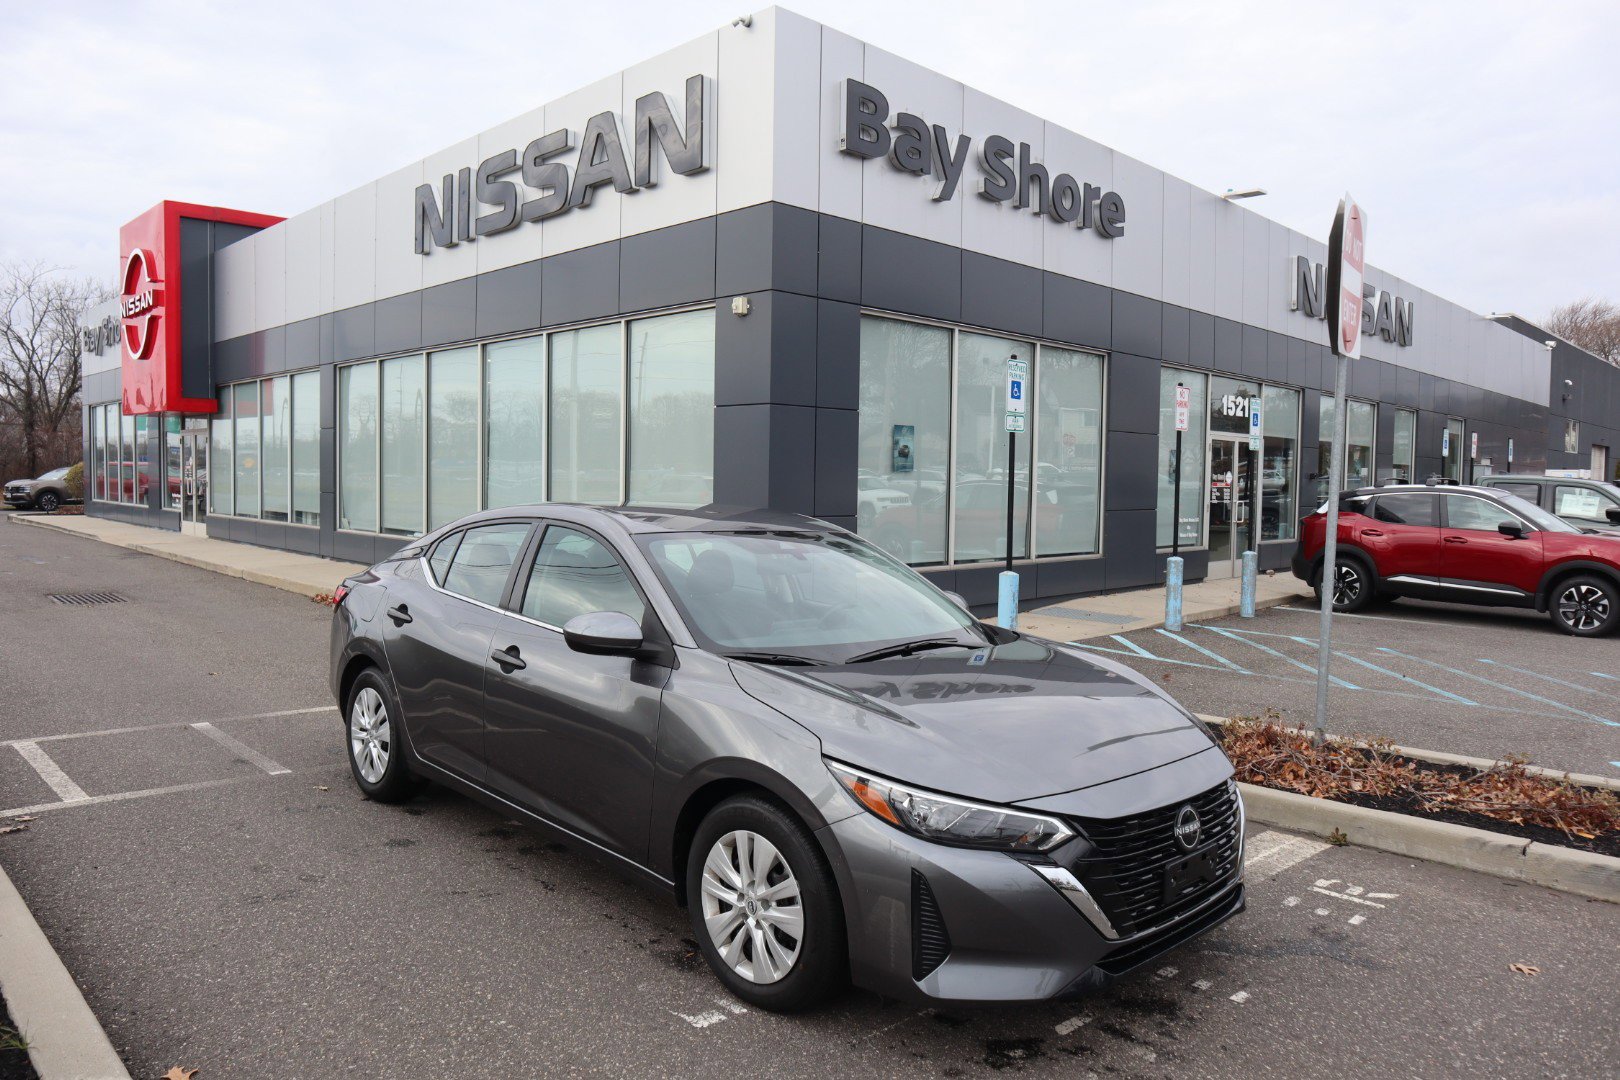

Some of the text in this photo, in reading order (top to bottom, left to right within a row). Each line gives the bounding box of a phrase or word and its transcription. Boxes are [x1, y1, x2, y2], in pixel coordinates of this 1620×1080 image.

[414, 73, 710, 256] NISSAN
[841, 78, 1126, 239] Bay Shore
[120, 288, 154, 319] NISSAN
[1292, 255, 1414, 347] NSAN
[1343, 299, 1357, 326] ENTER
[82, 314, 121, 356] Bay Sho
[1222, 394, 1249, 418] 1521
[1175, 821, 1201, 836] NISSAN
